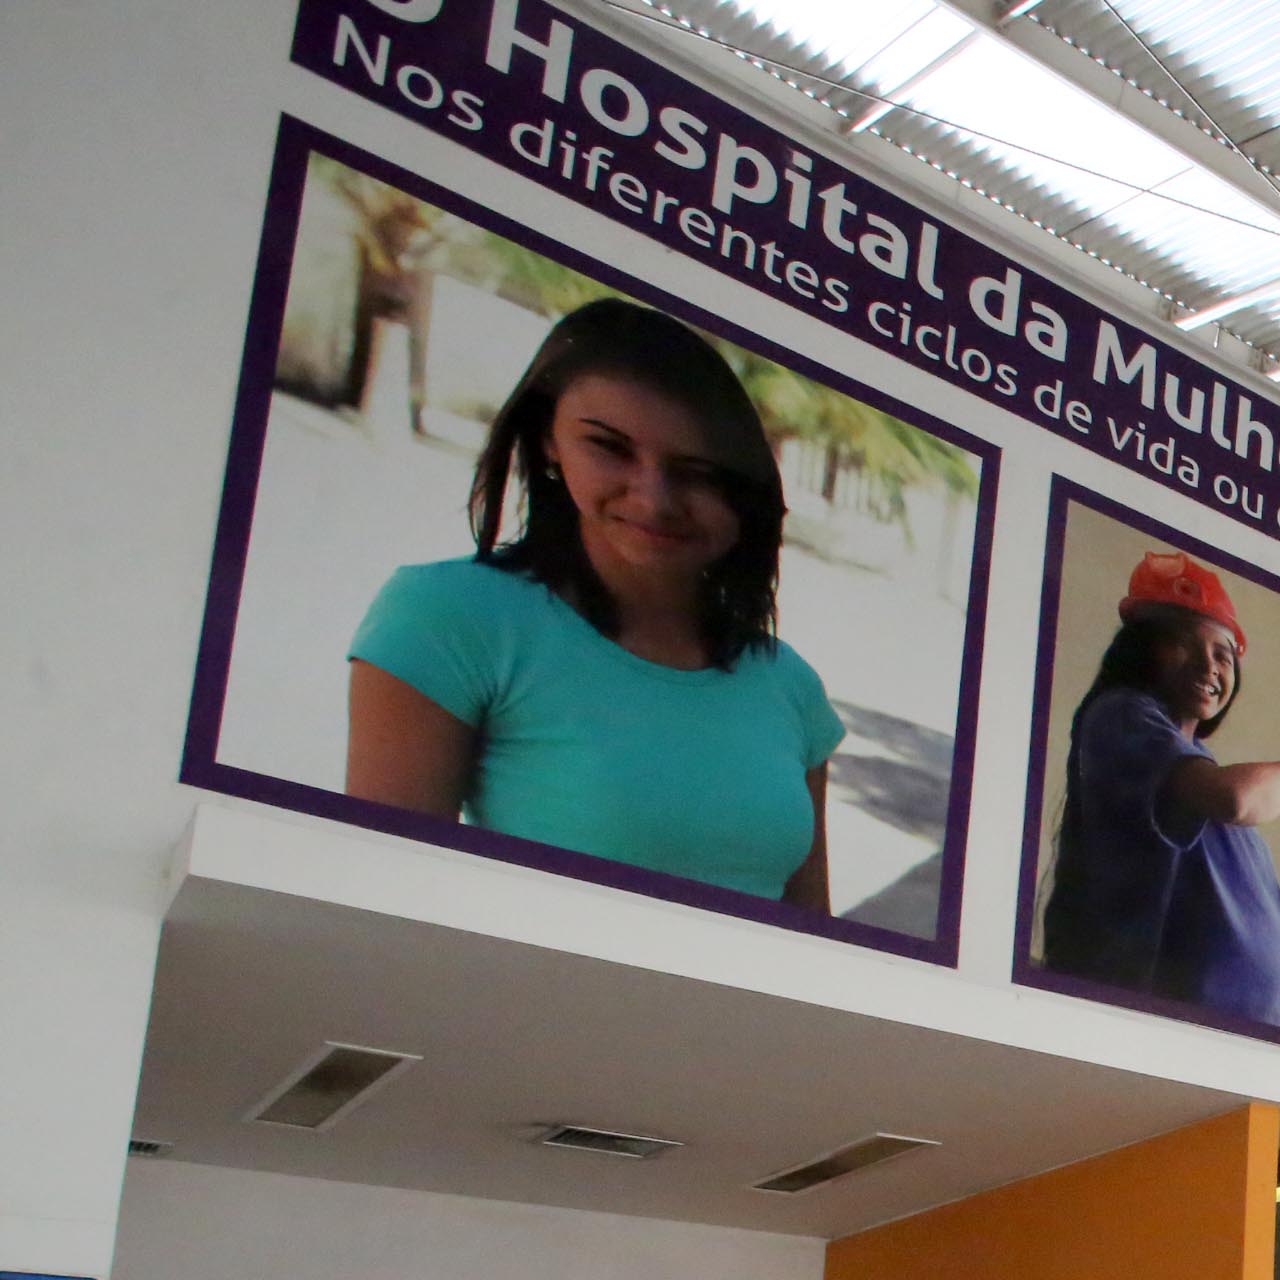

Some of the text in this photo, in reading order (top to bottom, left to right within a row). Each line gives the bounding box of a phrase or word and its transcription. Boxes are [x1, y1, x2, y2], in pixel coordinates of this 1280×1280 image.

[333, 14, 484, 131] Nos
[510, 118, 849, 313] diferentes
[867, 301, 1018, 396] ciclos
[1033, 379, 1093, 434] de
[1107, 416, 1200, 488] vida
[1213, 474, 1264, 520] ou
[485, 0, 944, 301] Hospital
[969, 267, 1068, 362] da
